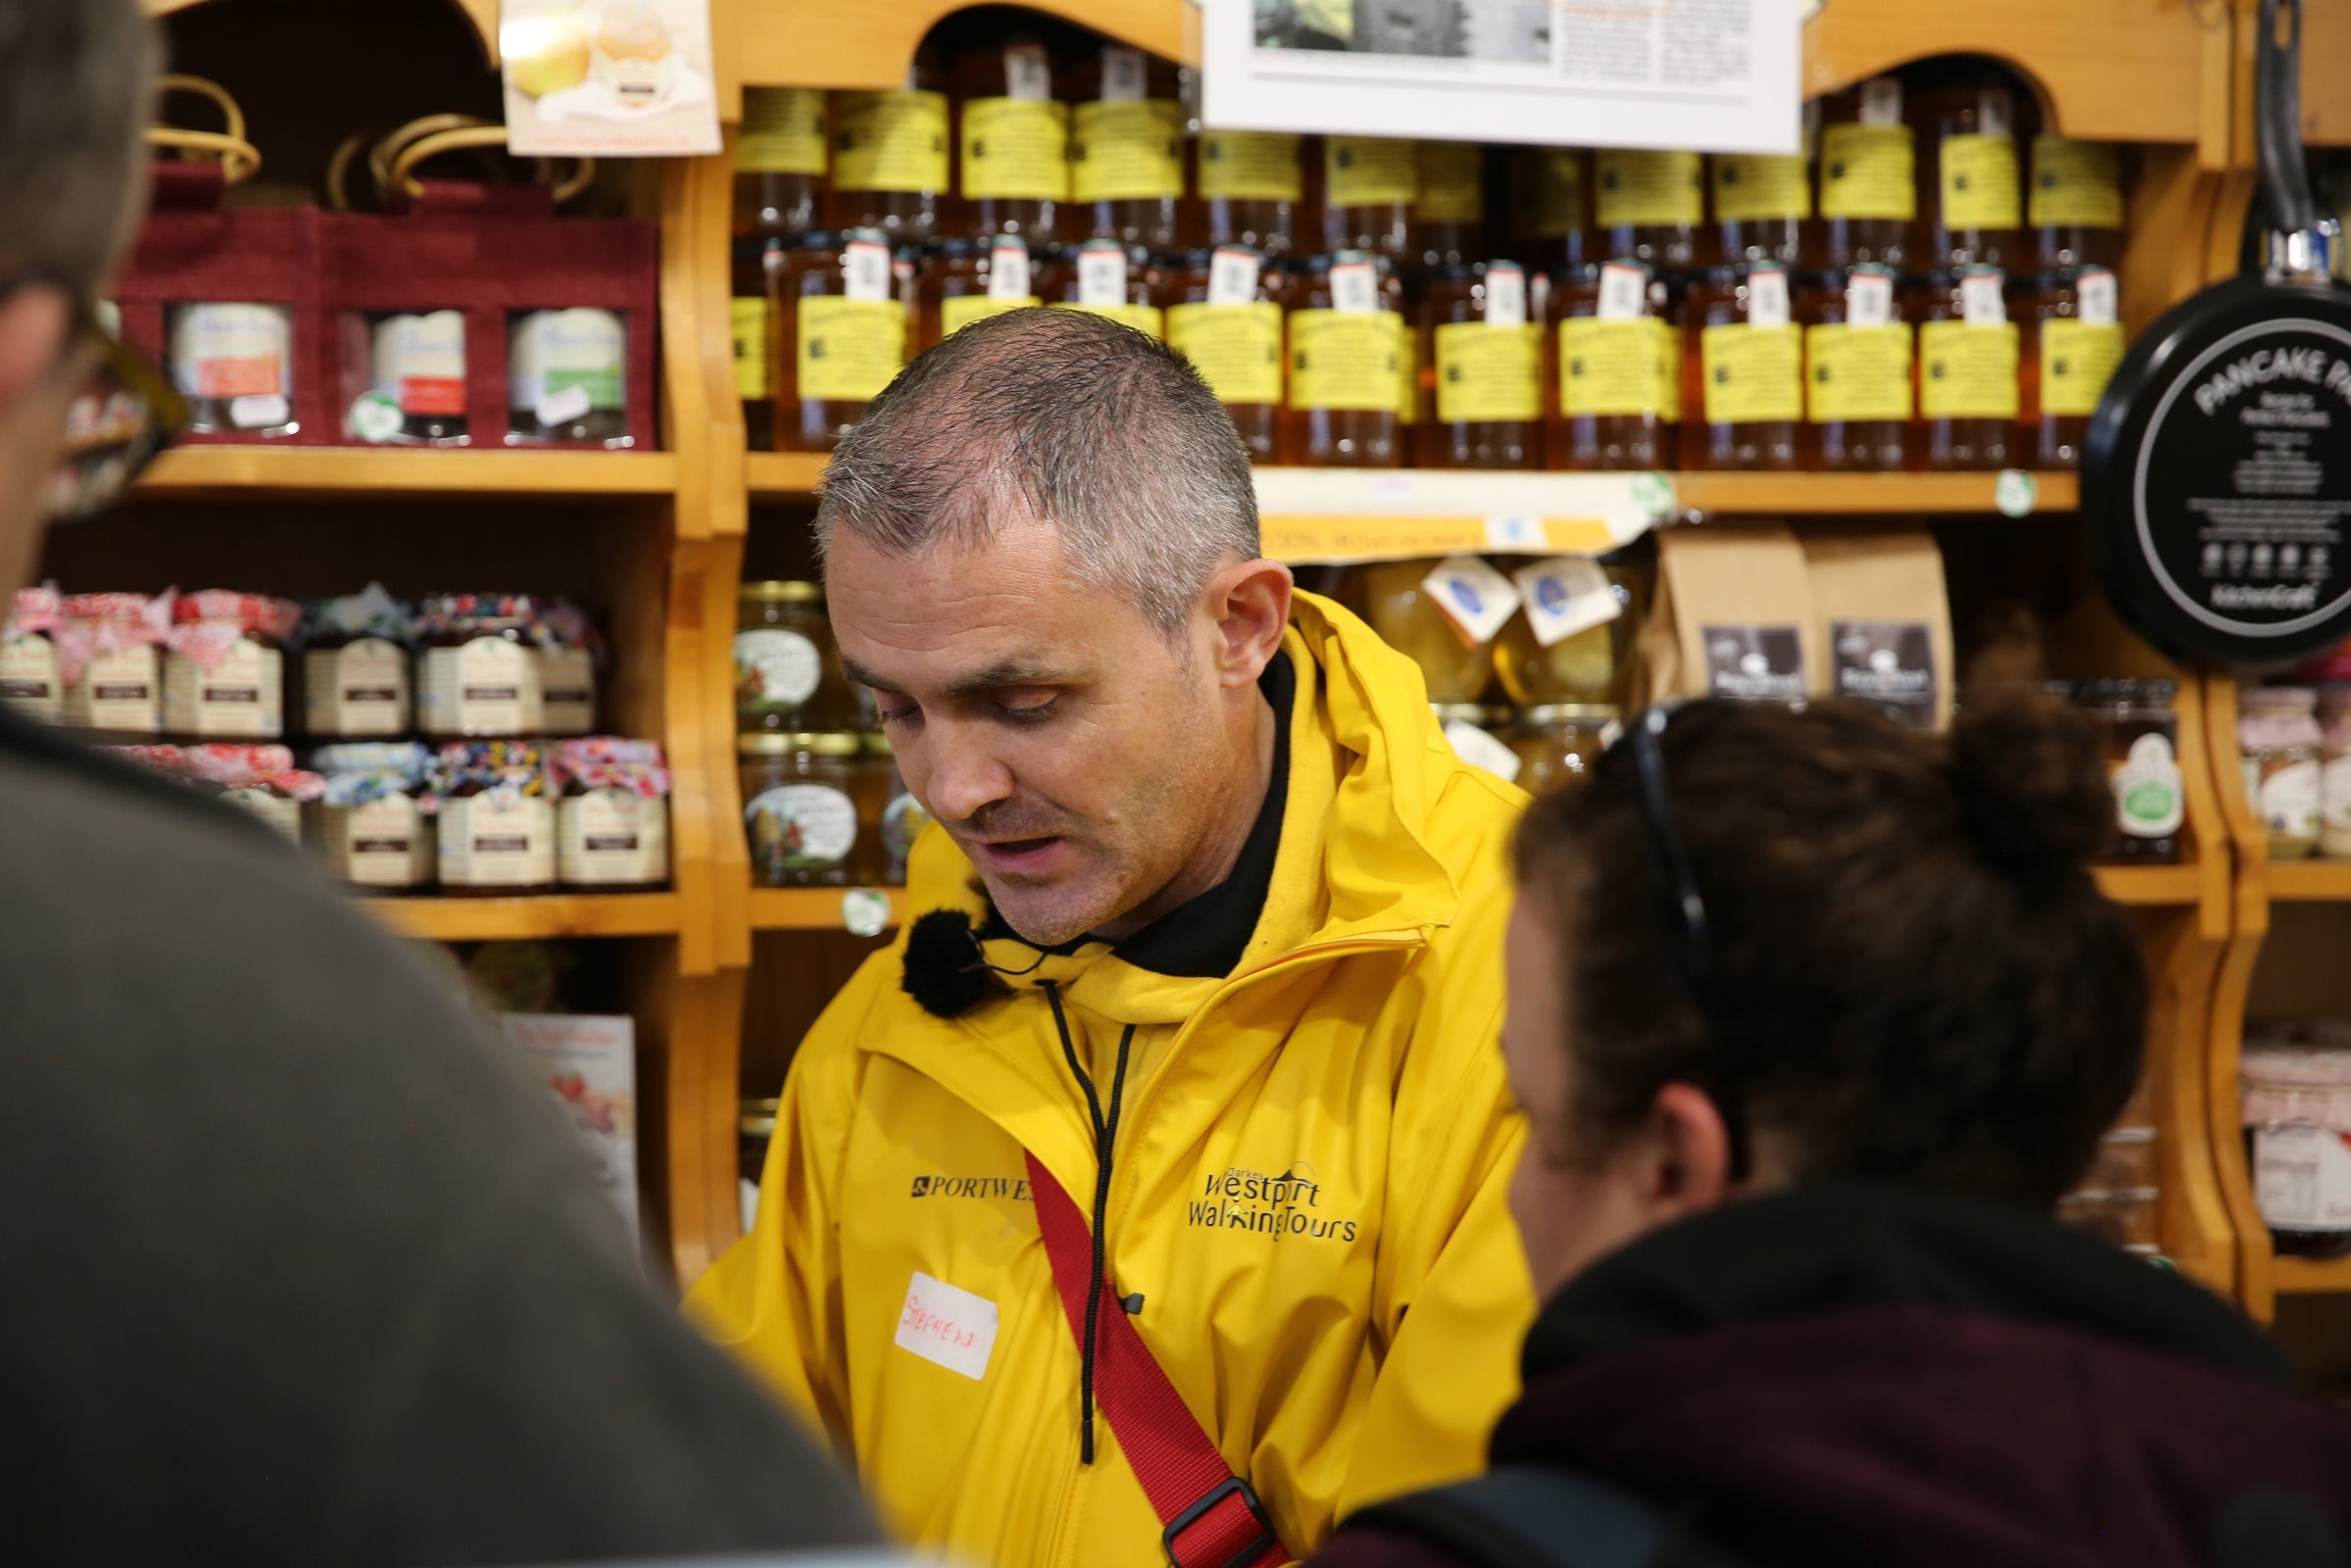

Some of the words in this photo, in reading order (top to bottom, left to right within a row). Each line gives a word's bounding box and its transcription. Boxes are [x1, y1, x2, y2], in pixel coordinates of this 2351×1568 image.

[2193, 346, 2328, 416] PANCAKE
[2324, 359, 2351, 408] PA
[931, 1176, 1035, 1202] PORTWE
[1283, 1205, 1358, 1243] Tours
[902, 1295, 976, 1348] STEPHEN
